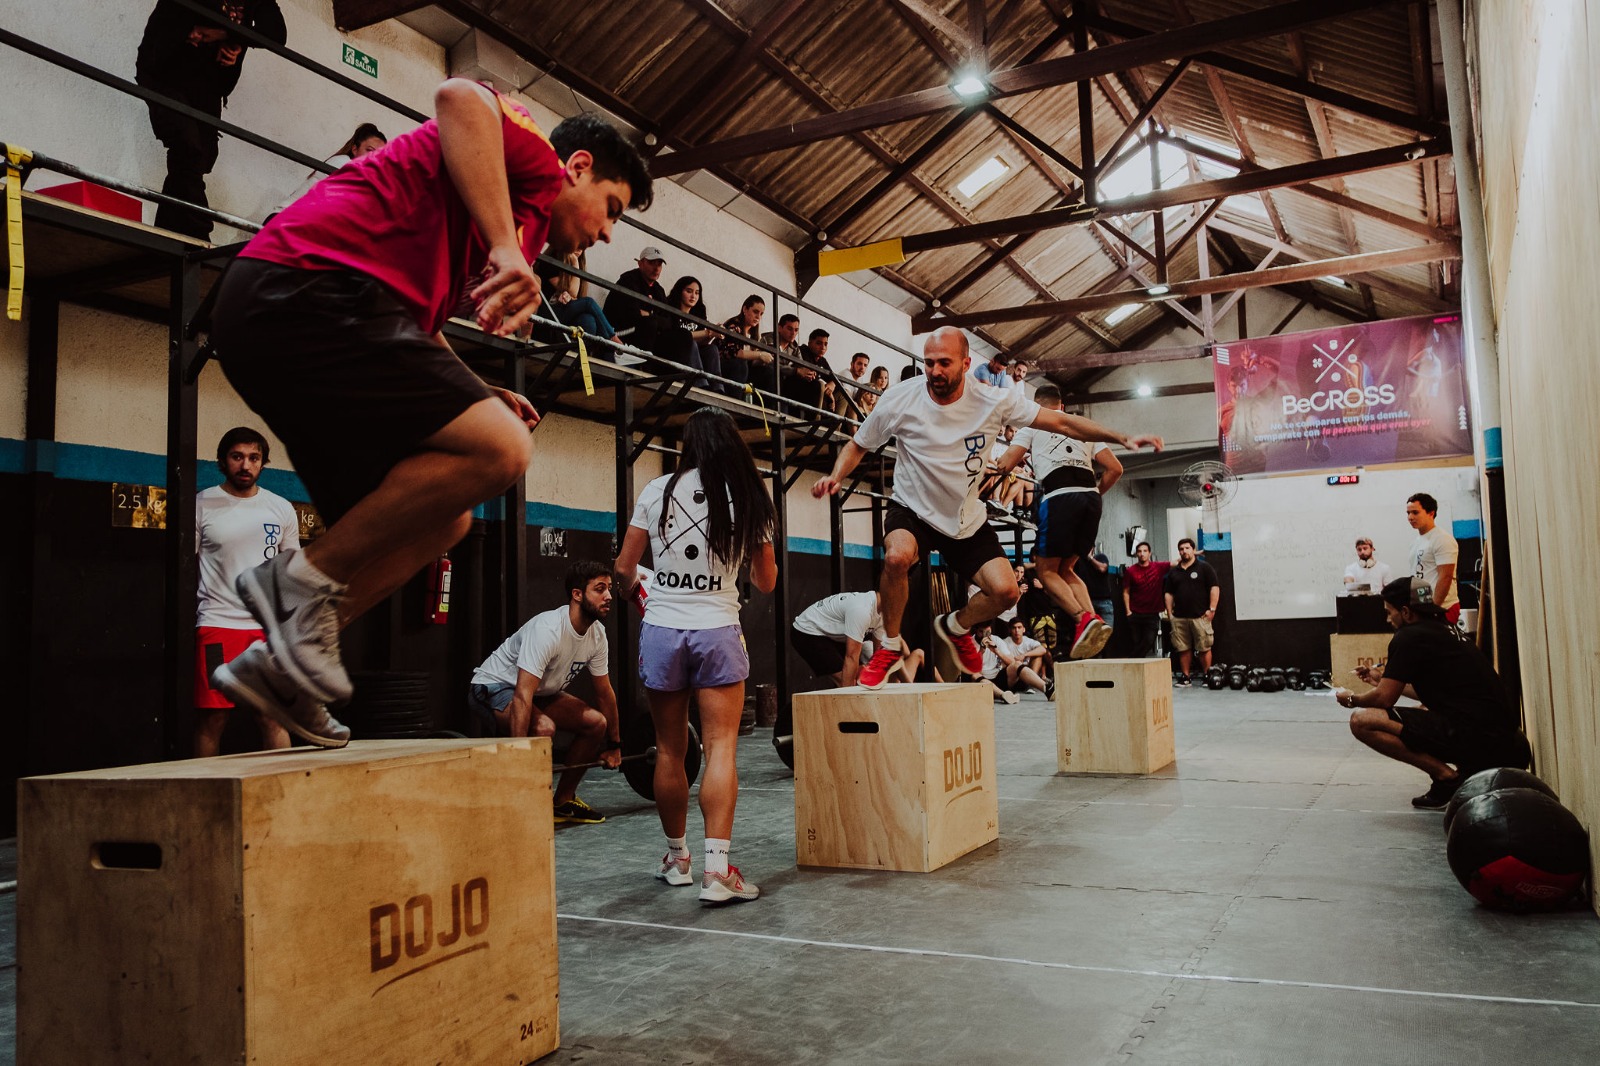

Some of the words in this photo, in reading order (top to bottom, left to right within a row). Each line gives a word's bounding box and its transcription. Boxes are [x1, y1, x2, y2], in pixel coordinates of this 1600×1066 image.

[355, 59, 376, 75] SALIDA
[1282, 384, 1396, 415] BeCROSS
[1303, 429, 1320, 437] con
[1322, 427, 1331, 435] la
[1333, 424, 1369, 436] persona
[1370, 422, 1387, 433] que
[118, 493, 141, 509] 2.5
[146, 495, 164, 515] kg
[301, 509, 315, 527] kg
[543, 533, 553, 544] 10
[554, 532, 563, 547] kg
[656, 571, 722, 591] COACH
[1152, 695, 1169, 726] DOJO
[1065, 748, 1072, 757] 20
[943, 741, 982, 793] DOJO
[807, 828, 817, 841] 20
[369, 876, 491, 974] DOJO
[520, 1020, 534, 1042] 24
